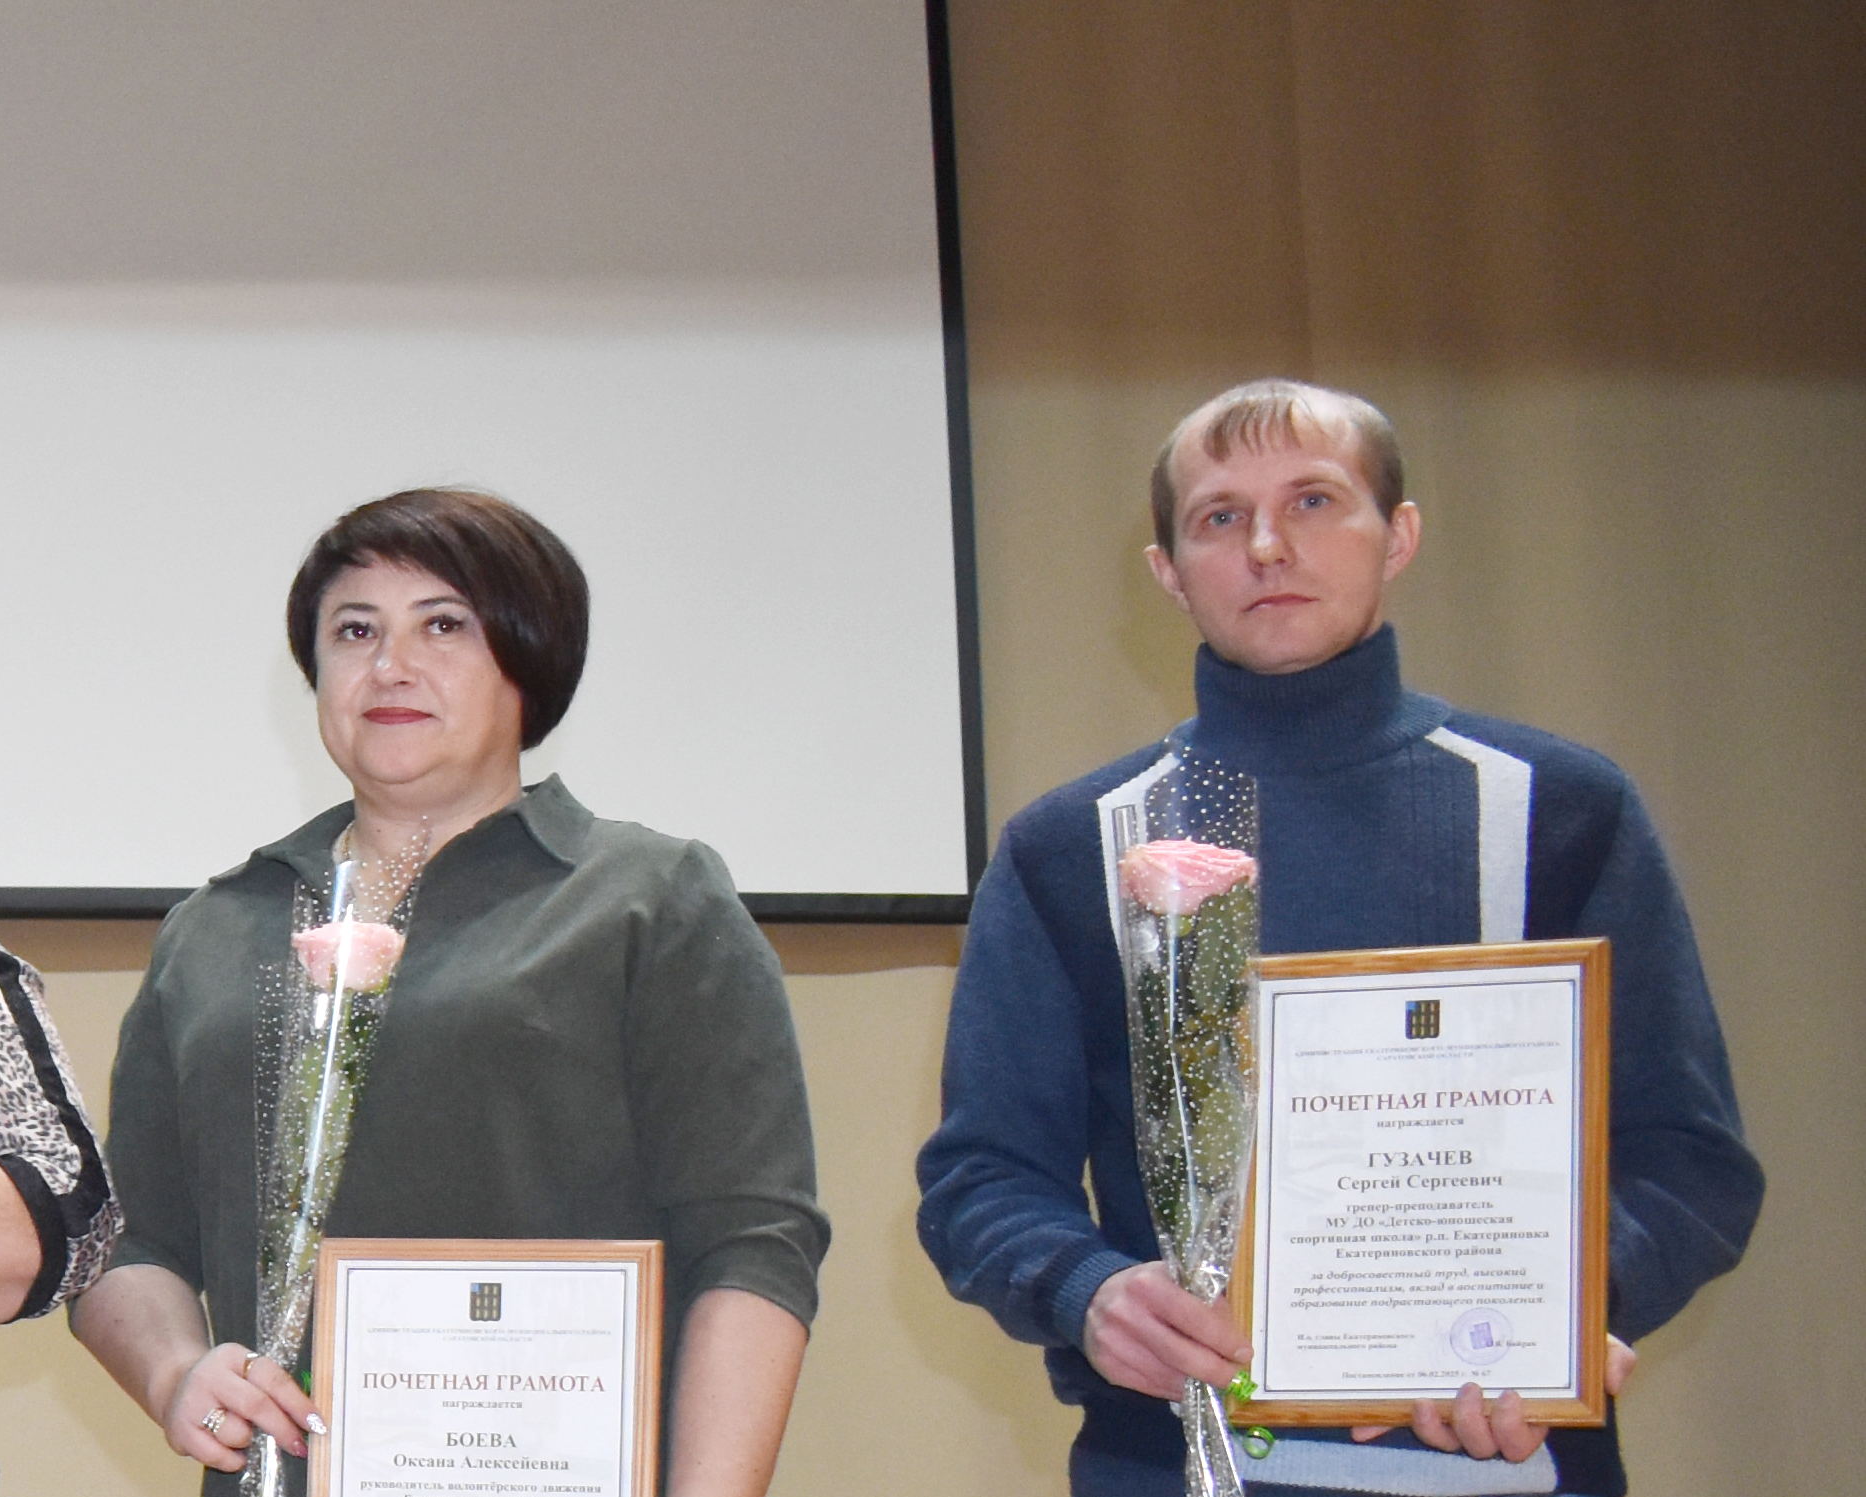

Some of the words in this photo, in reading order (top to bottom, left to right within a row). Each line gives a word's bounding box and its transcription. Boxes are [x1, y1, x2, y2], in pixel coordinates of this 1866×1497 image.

[1291, 1093, 1427, 1113] ПОЧЕТНАЯ
[1435, 1088, 1554, 1109] ГРАМОТА
[1377, 1117, 1464, 1129] награждается
[1368, 1150, 1473, 1168] ГУЗАЧЕВ
[1337, 1175, 1400, 1193] Сергей
[1407, 1174, 1503, 1190] Сергеевич
[1325, 1217, 1348, 1228] МУ
[1353, 1217, 1375, 1229] ДО
[1290, 1233, 1366, 1246] спортивная
[1454, 1230, 1550, 1244] Екатериновка
[1336, 1247, 1451, 1260] Екатериновского
[1455, 1246, 1503, 1258] района
[1326, 1269, 1431, 1282] добросовестный
[1473, 1267, 1526, 1277] высокий
[362, 1372, 489, 1391] ПОЧЕТНАЯ
[496, 1374, 605, 1393] ГРАМОТА
[442, 1399, 523, 1411] награждается
[446, 1432, 517, 1449] БОЕВА
[393, 1453, 455, 1468] Оксана
[460, 1454, 570, 1471] Алексейевна
